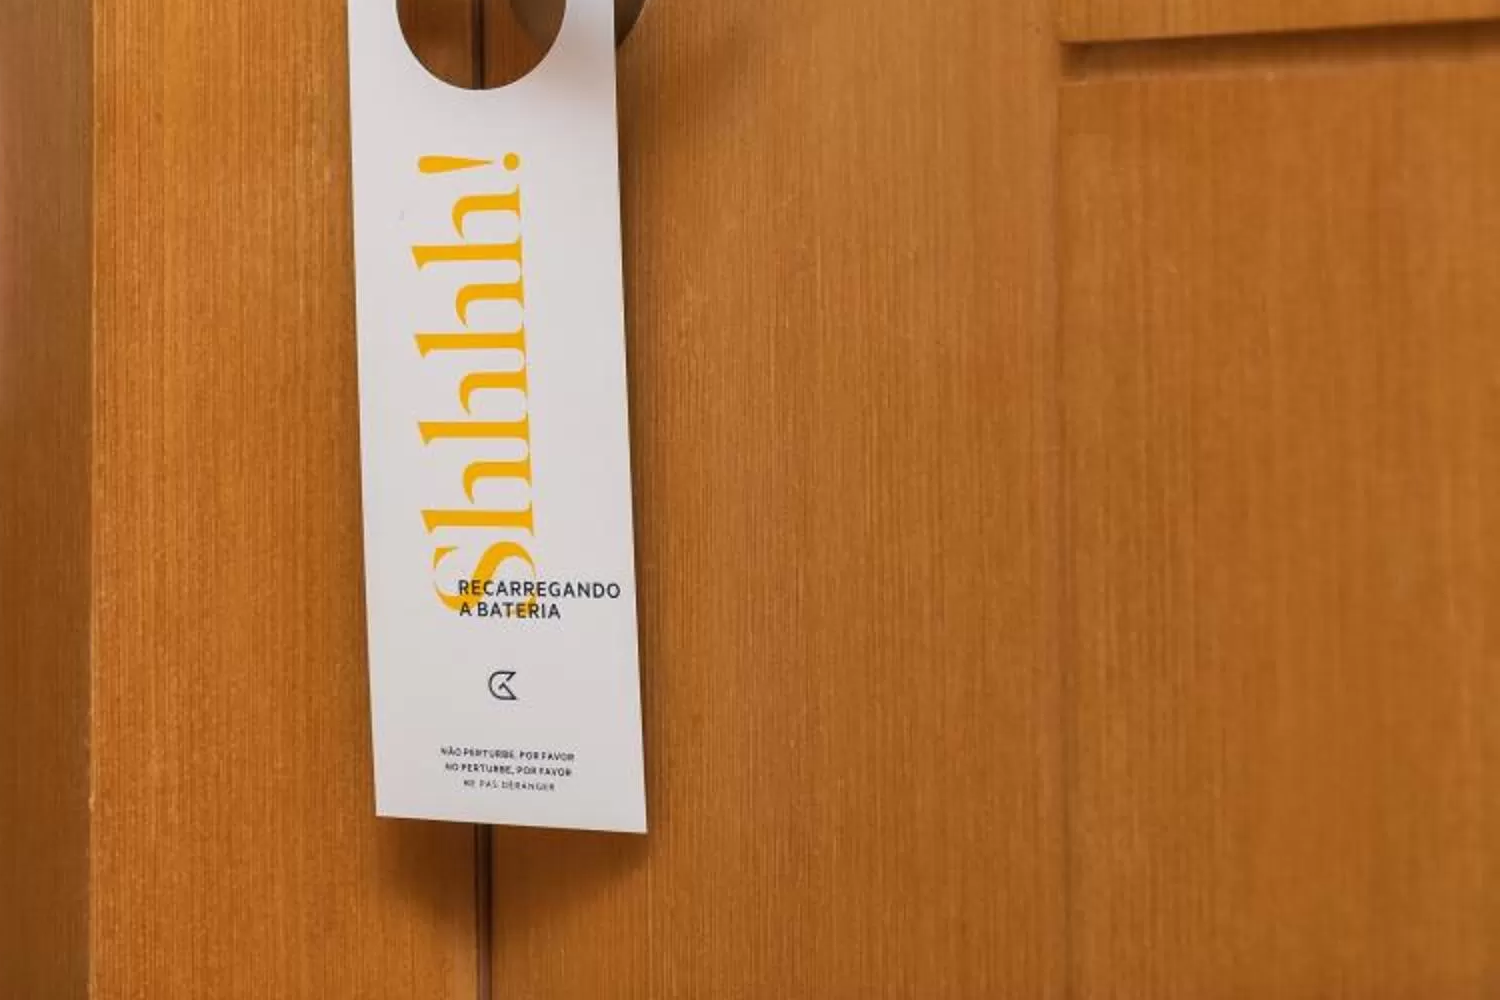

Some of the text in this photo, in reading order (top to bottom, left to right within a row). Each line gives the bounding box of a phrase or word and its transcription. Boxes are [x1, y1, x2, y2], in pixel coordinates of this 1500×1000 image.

[411, 151, 537, 617] Shhhh!
[458, 579, 621, 599] RECARREGANDO
[459, 602, 561, 619] A BATERIA
[519, 751, 539, 760] POR
[541, 752, 575, 761] FAVOR
[445, 763, 458, 771] NO
[516, 766, 537, 774] POR
[539, 767, 572, 776] FAVOR
